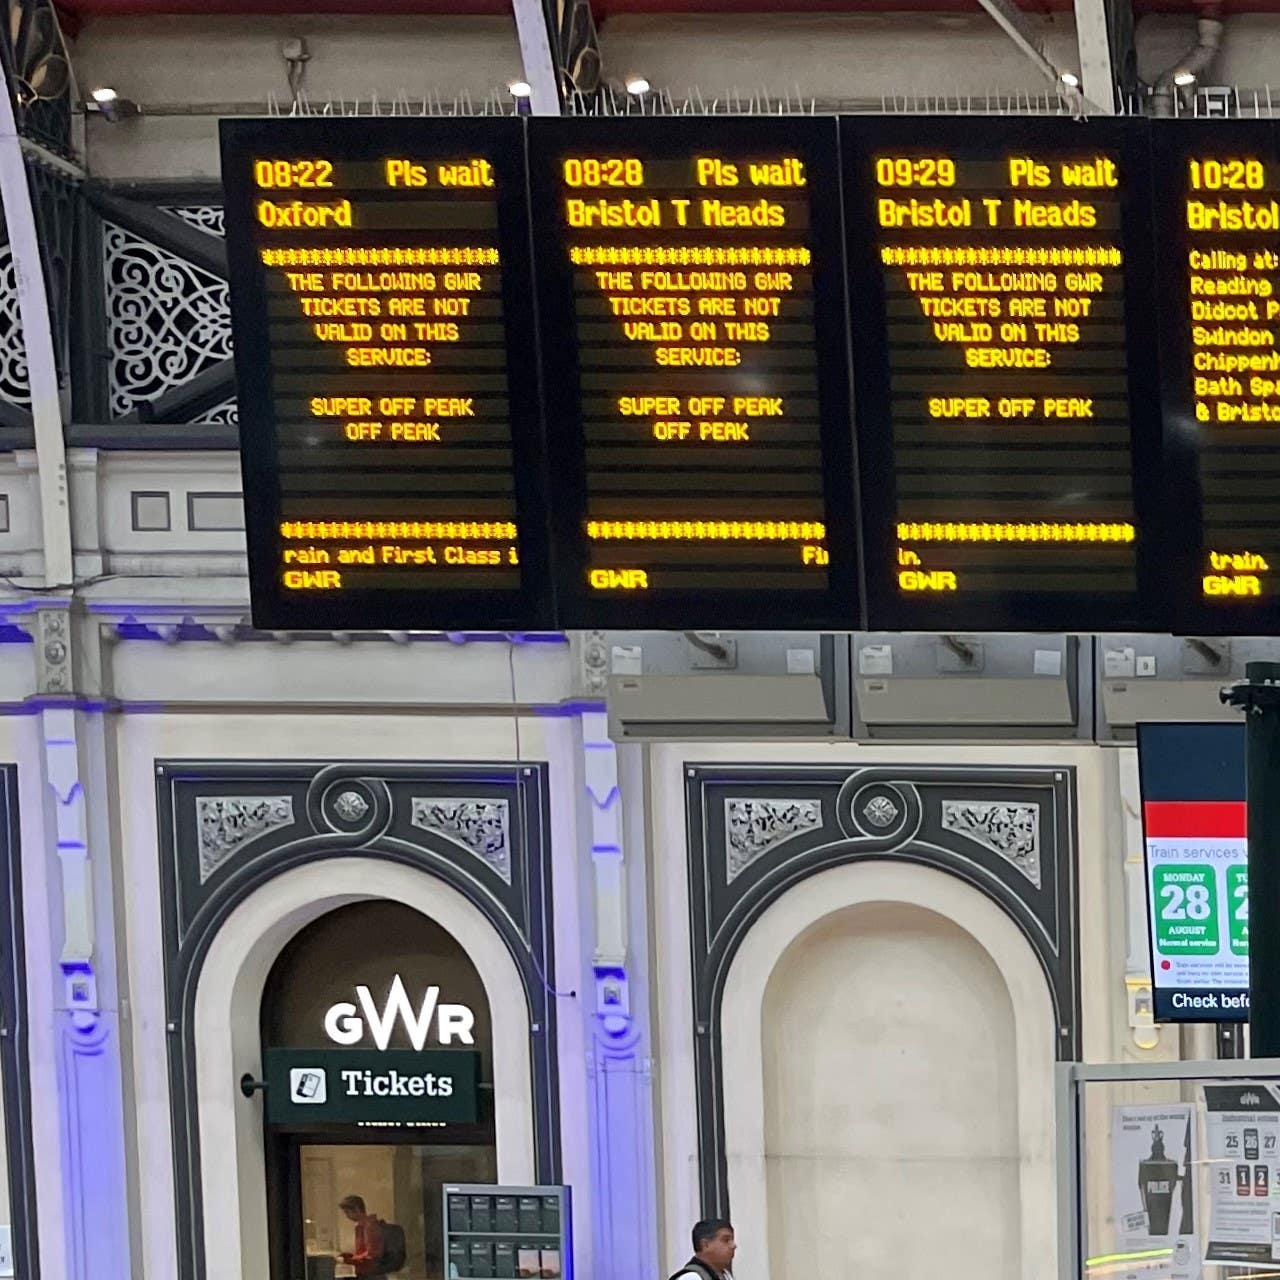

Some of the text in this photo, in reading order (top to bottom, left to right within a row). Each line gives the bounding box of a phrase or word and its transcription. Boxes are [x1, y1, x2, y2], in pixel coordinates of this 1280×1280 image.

[256, 159, 494, 187] 08:22 Pls wait
[564, 159, 806, 186] 08:28 Pls wait
[1190, 160, 1264, 189] 10:28
[258, 200, 351, 227] Oxford
[567, 199, 785, 227] Bristol T Meads
[1187, 200, 1279, 230] Bristol
[1189, 250, 1278, 271] Calling at:
[285, 272, 481, 291] THE FOLLOWING GWR
[1191, 276, 1272, 297] Reading
[301, 298, 470, 316] TICKETS ARE NOT
[1191, 301, 1258, 321] Didcot
[315, 323, 459, 341] VALID ON THIS
[1193, 326, 1274, 346] Swindon
[346, 348, 431, 366] SERVICE:
[1195, 376, 1242, 396] Bath
[310, 398, 474, 416] SUPER OFF PEAK
[345, 422, 440, 440] OFF PEAK
[325, 974, 475, 1051] GWR
[342, 1071, 453, 1097] Tickets
